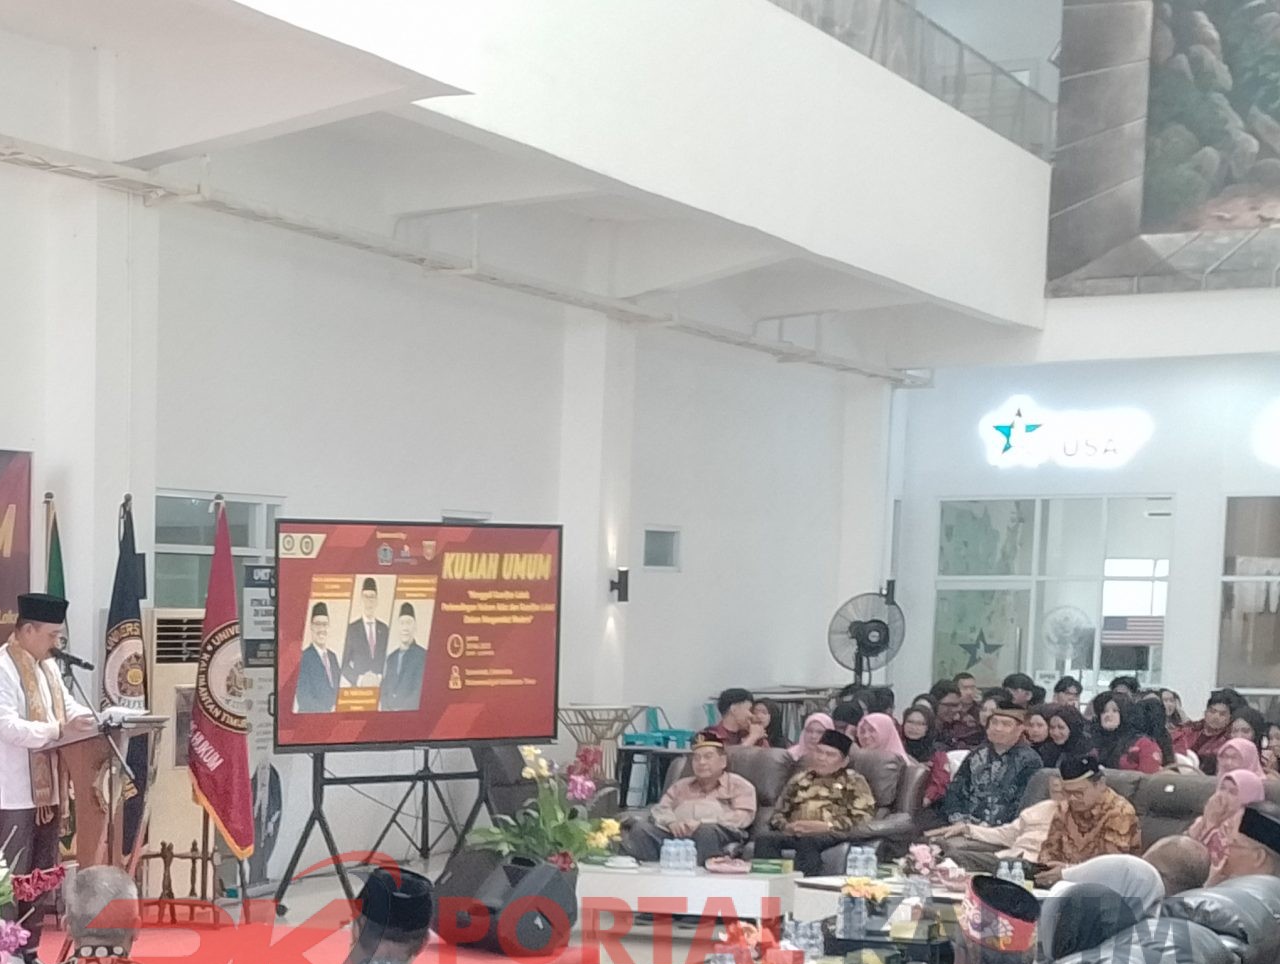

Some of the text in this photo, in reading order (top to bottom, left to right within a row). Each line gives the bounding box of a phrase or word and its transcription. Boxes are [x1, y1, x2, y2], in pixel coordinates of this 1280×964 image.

[1063, 438, 1118, 457] USA
[442, 552, 552, 580] KULIAH UMUM
